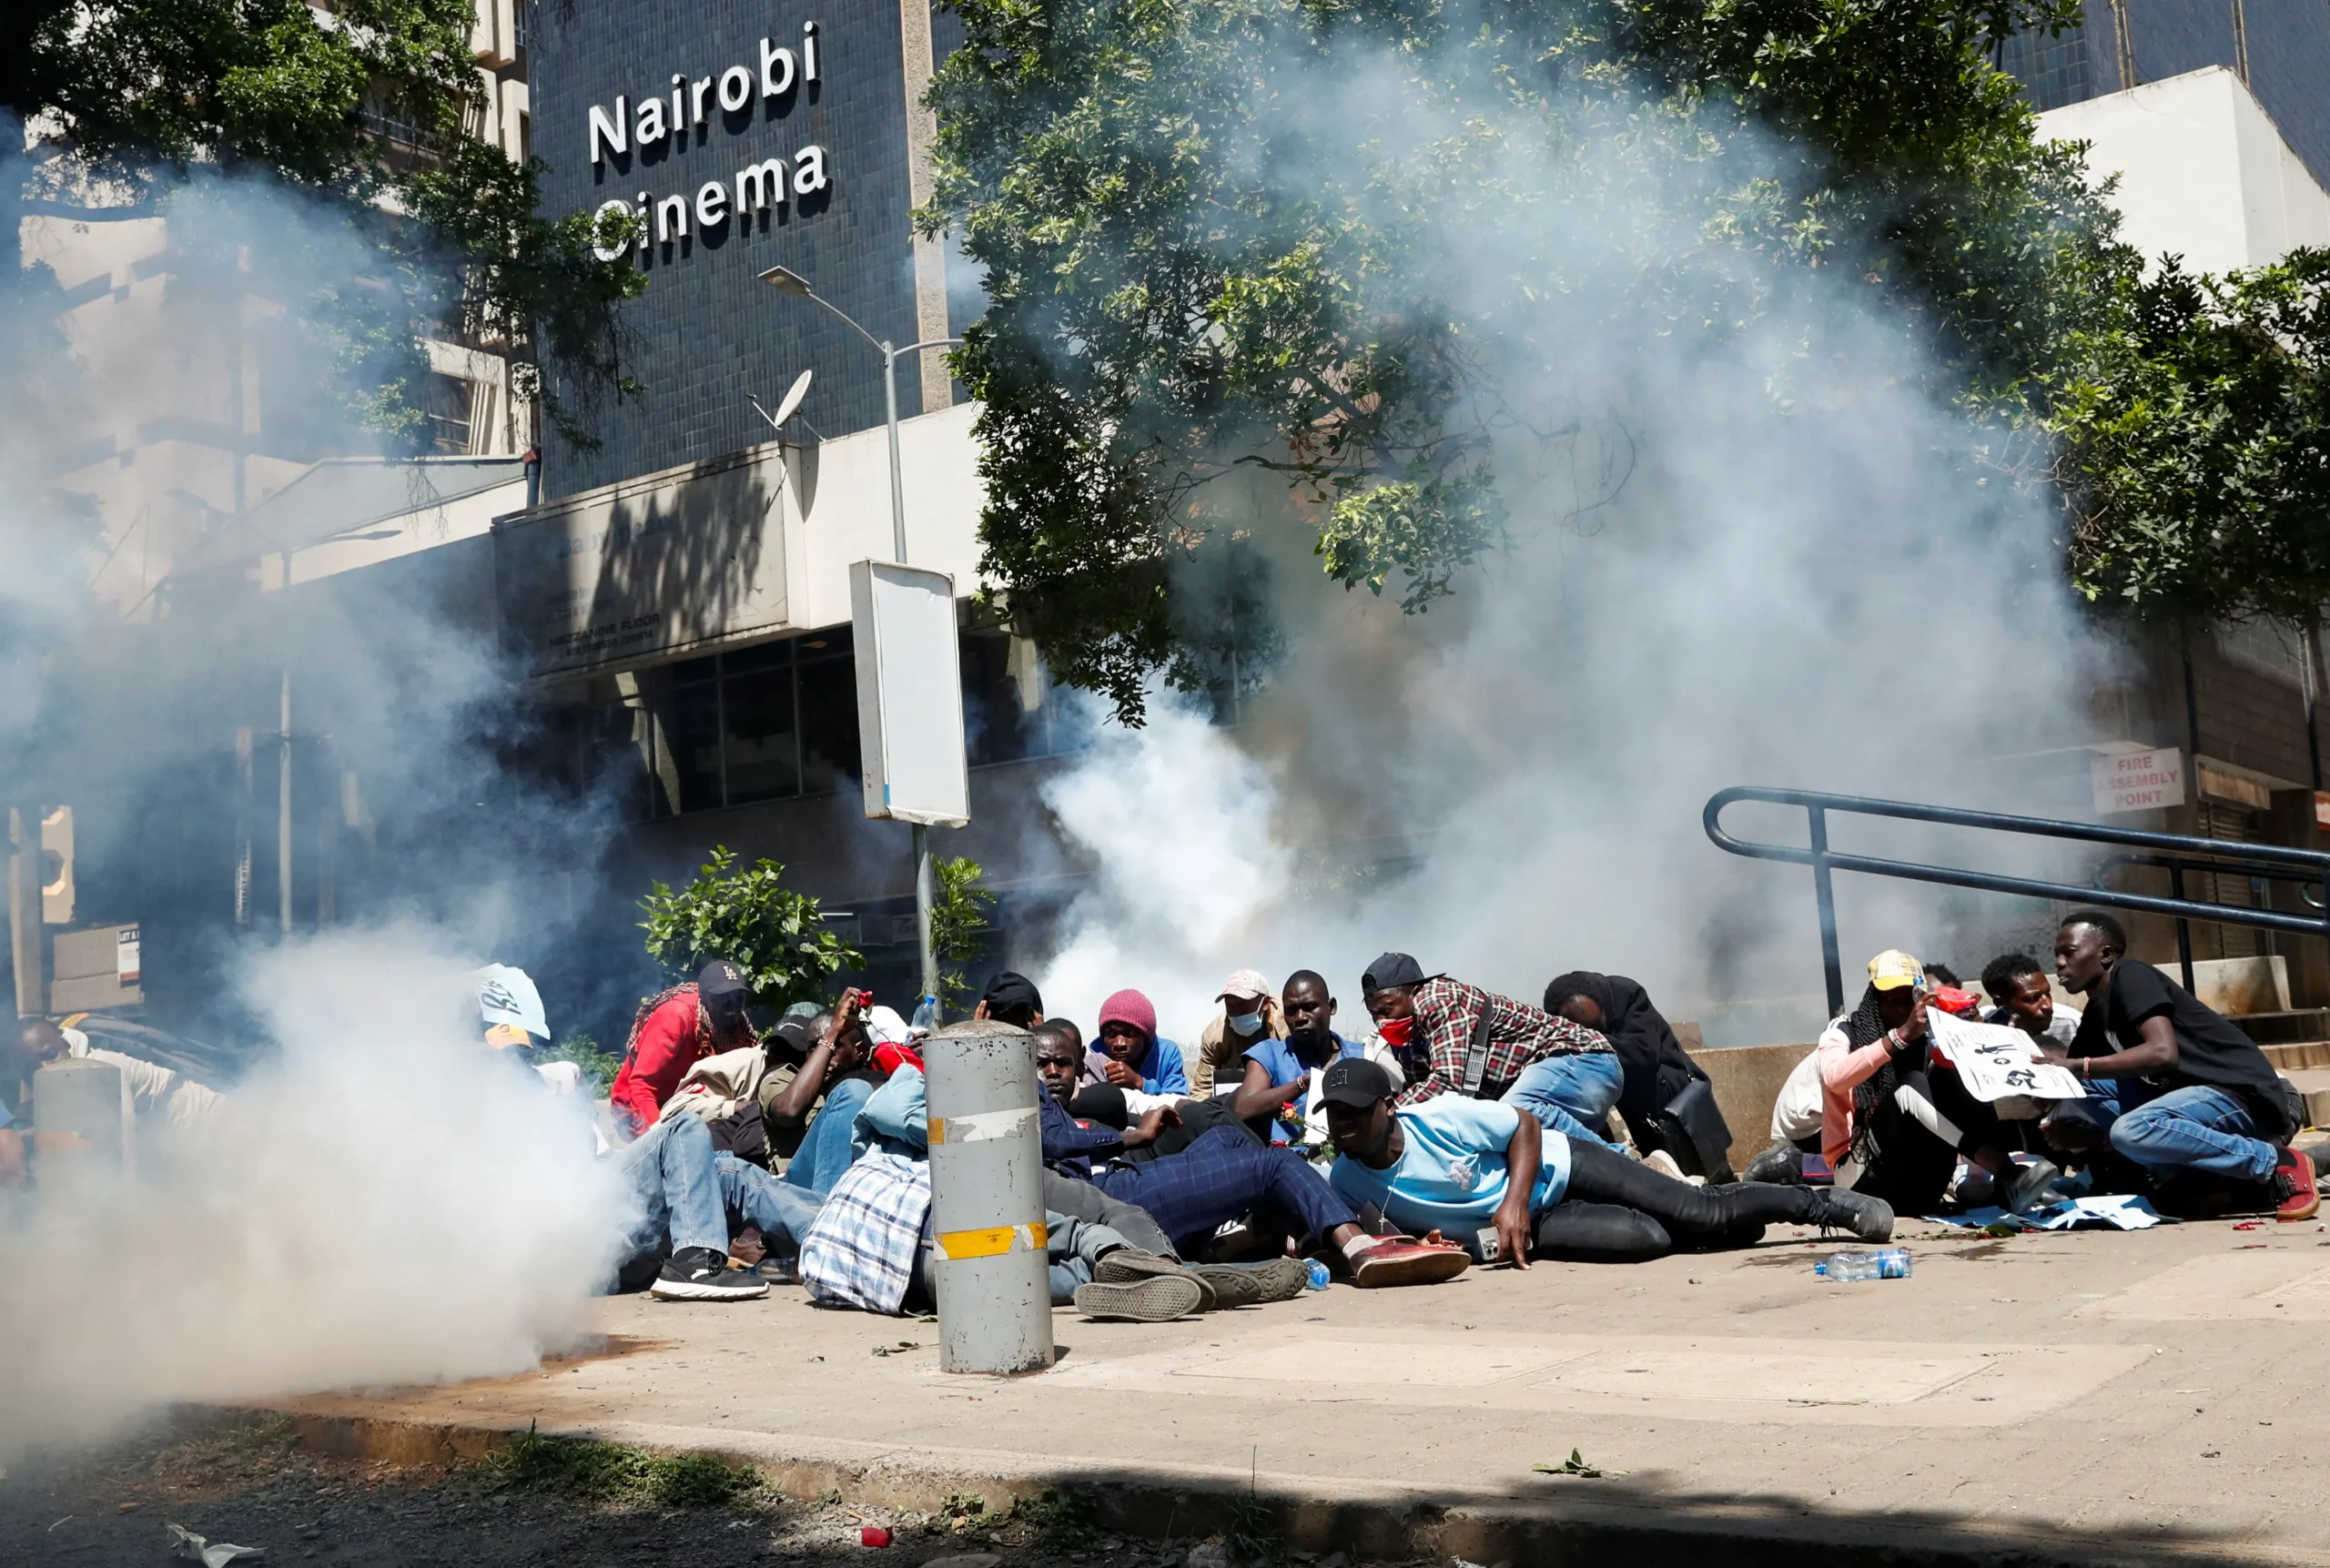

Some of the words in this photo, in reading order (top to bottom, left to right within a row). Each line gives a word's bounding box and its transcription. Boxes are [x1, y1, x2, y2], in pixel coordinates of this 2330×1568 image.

[588, 20, 820, 165] Nairobi
[593, 144, 829, 263] Cinema
[621, 613, 661, 632] FLOOR
[2117, 755, 2153, 772] FIRE
[2096, 770, 2180, 792] ASSEMBLY
[2115, 790, 2163, 808] POINT
[722, 965, 739, 981] LA
